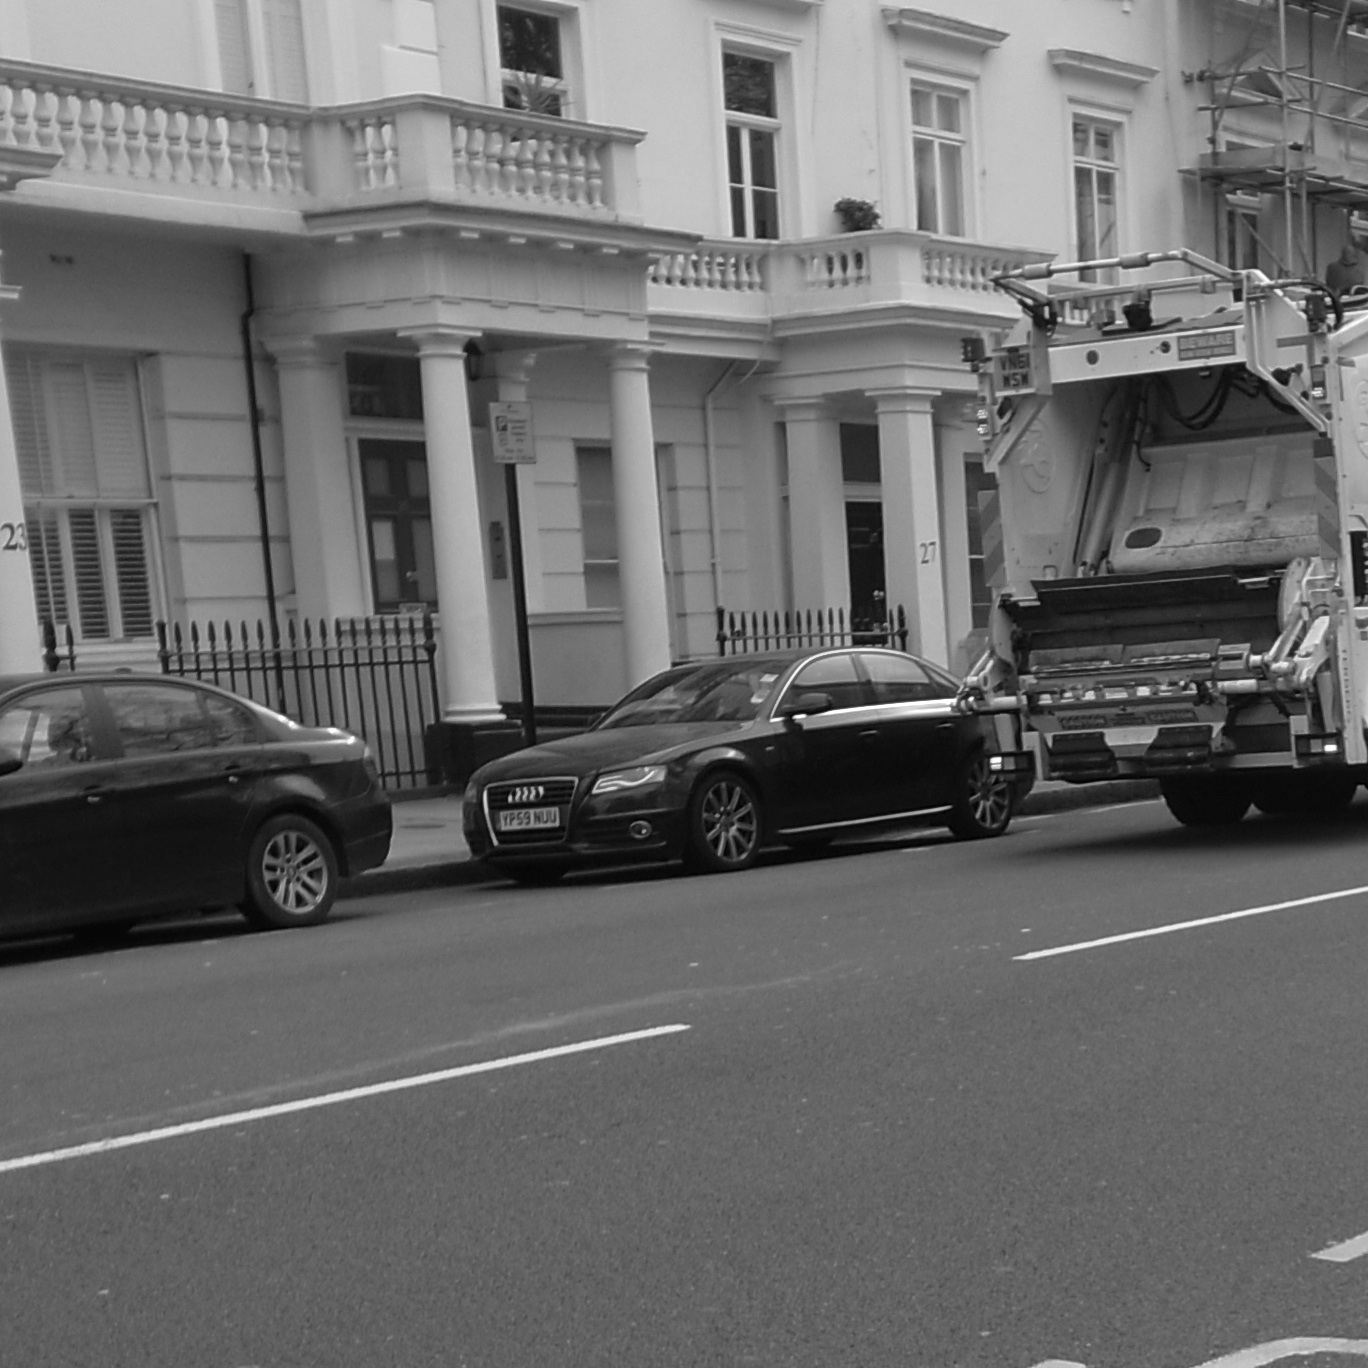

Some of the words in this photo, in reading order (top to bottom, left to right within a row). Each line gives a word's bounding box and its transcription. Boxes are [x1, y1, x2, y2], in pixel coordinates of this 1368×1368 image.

[1179, 332, 1234, 350] BEWARE
[0, 522, 28, 551] 23
[919, 541, 937, 565] 27
[502, 810, 531, 827] YP59
